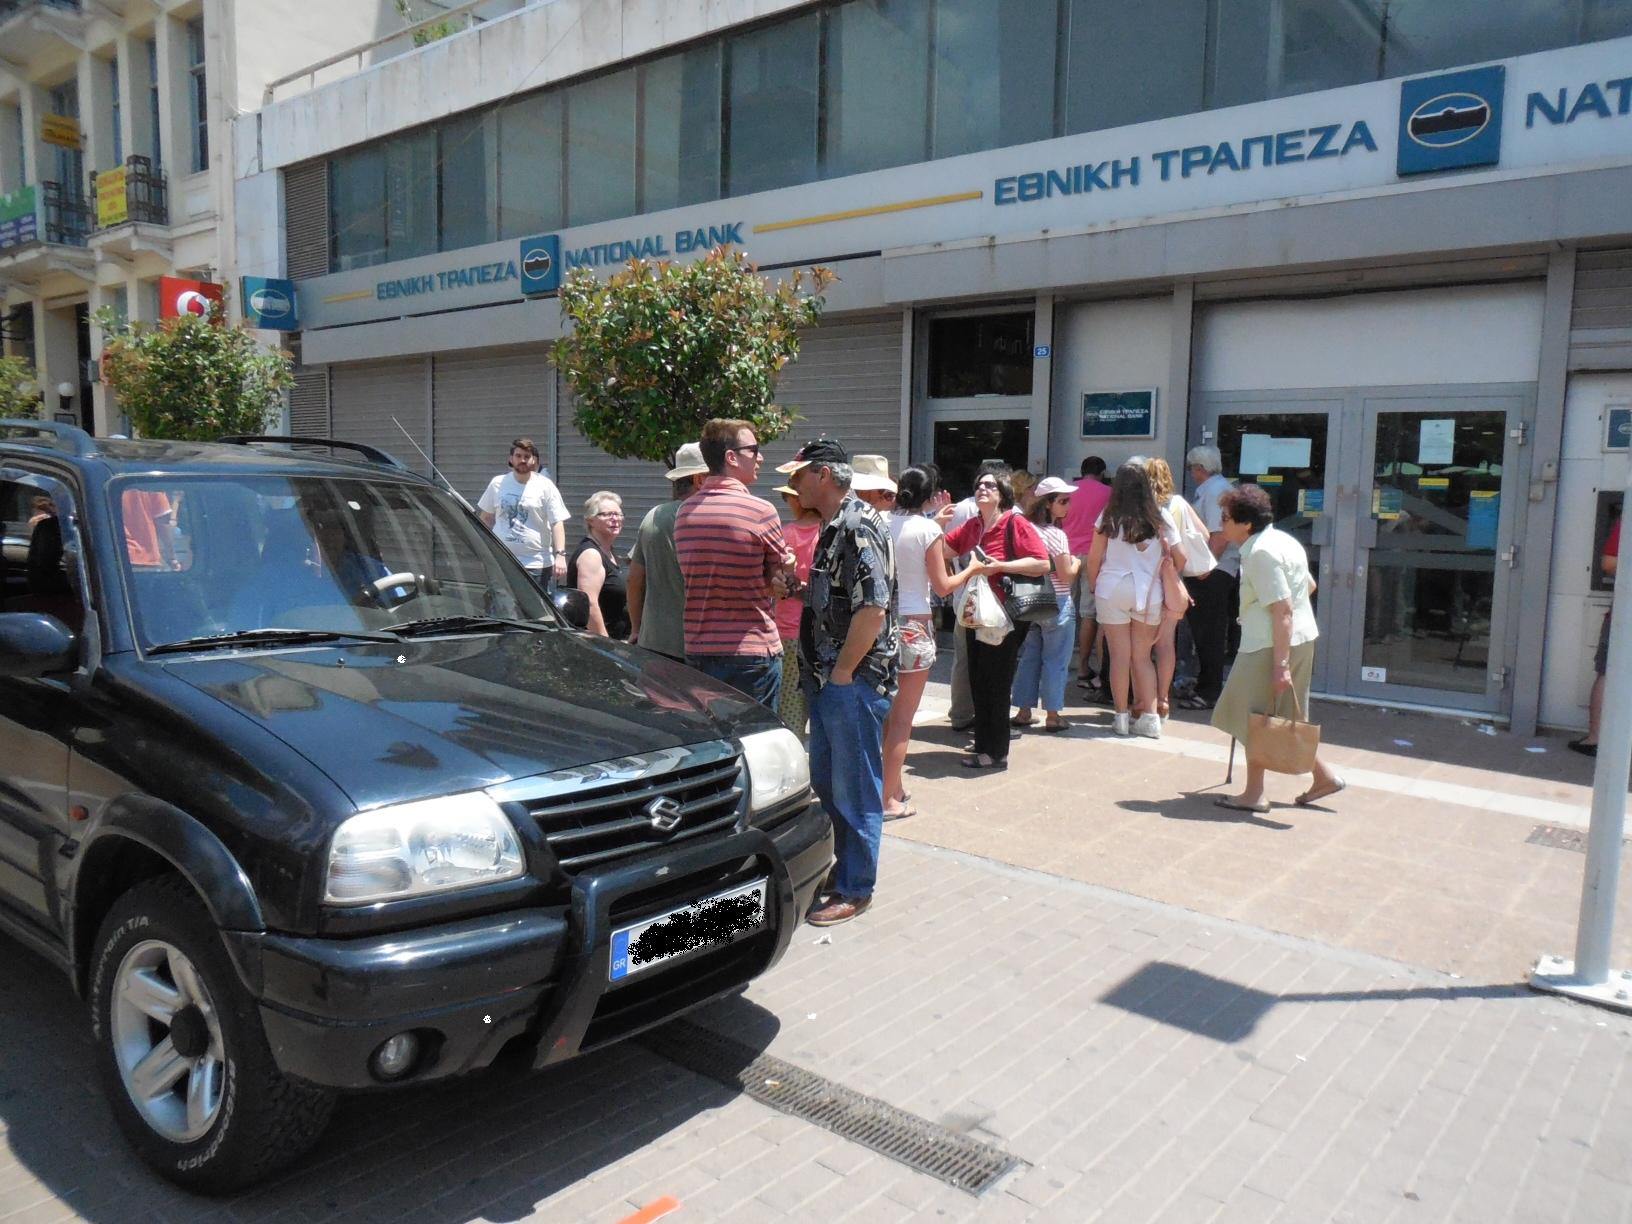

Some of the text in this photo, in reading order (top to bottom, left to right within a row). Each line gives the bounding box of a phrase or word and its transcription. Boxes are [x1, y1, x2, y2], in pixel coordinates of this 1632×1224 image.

[994, 120, 1379, 206] ΕΘΝΙΚΗ ΤΡΑΠΕΖΑ
[565, 221, 745, 268] NATIONAL BANK
[376, 259, 518, 301] ΕΘΝΙΚΗ ΤΡΑΠΕΖΑ
[613, 957, 626, 970] GR
